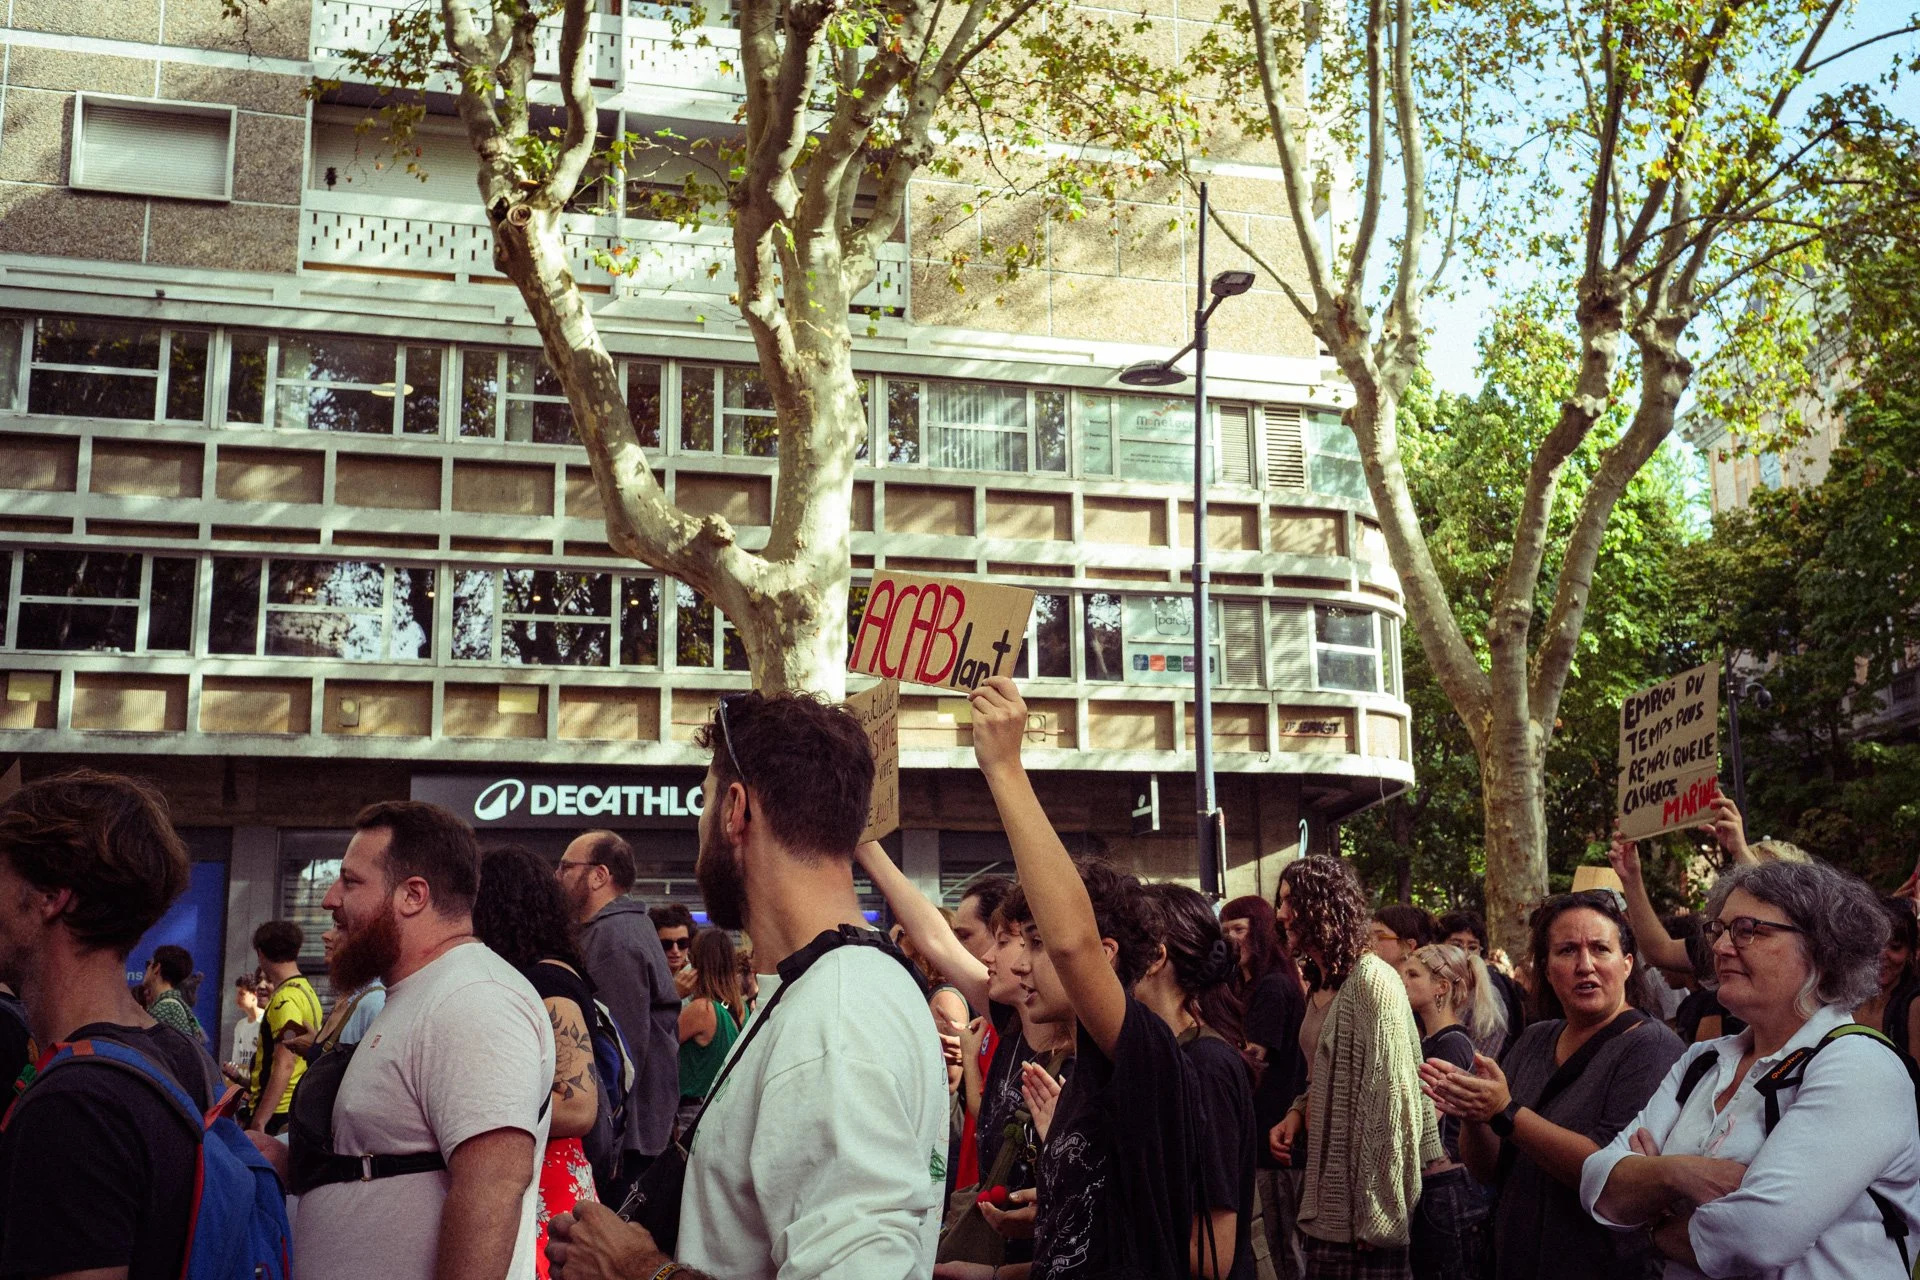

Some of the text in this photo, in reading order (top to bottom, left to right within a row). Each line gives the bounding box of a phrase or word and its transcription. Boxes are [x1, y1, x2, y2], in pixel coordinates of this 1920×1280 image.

[1686, 673, 1706, 697] DU
[1625, 701, 1704, 755] TEMPS PLUS
[530, 785, 704, 816] DECATHLO
